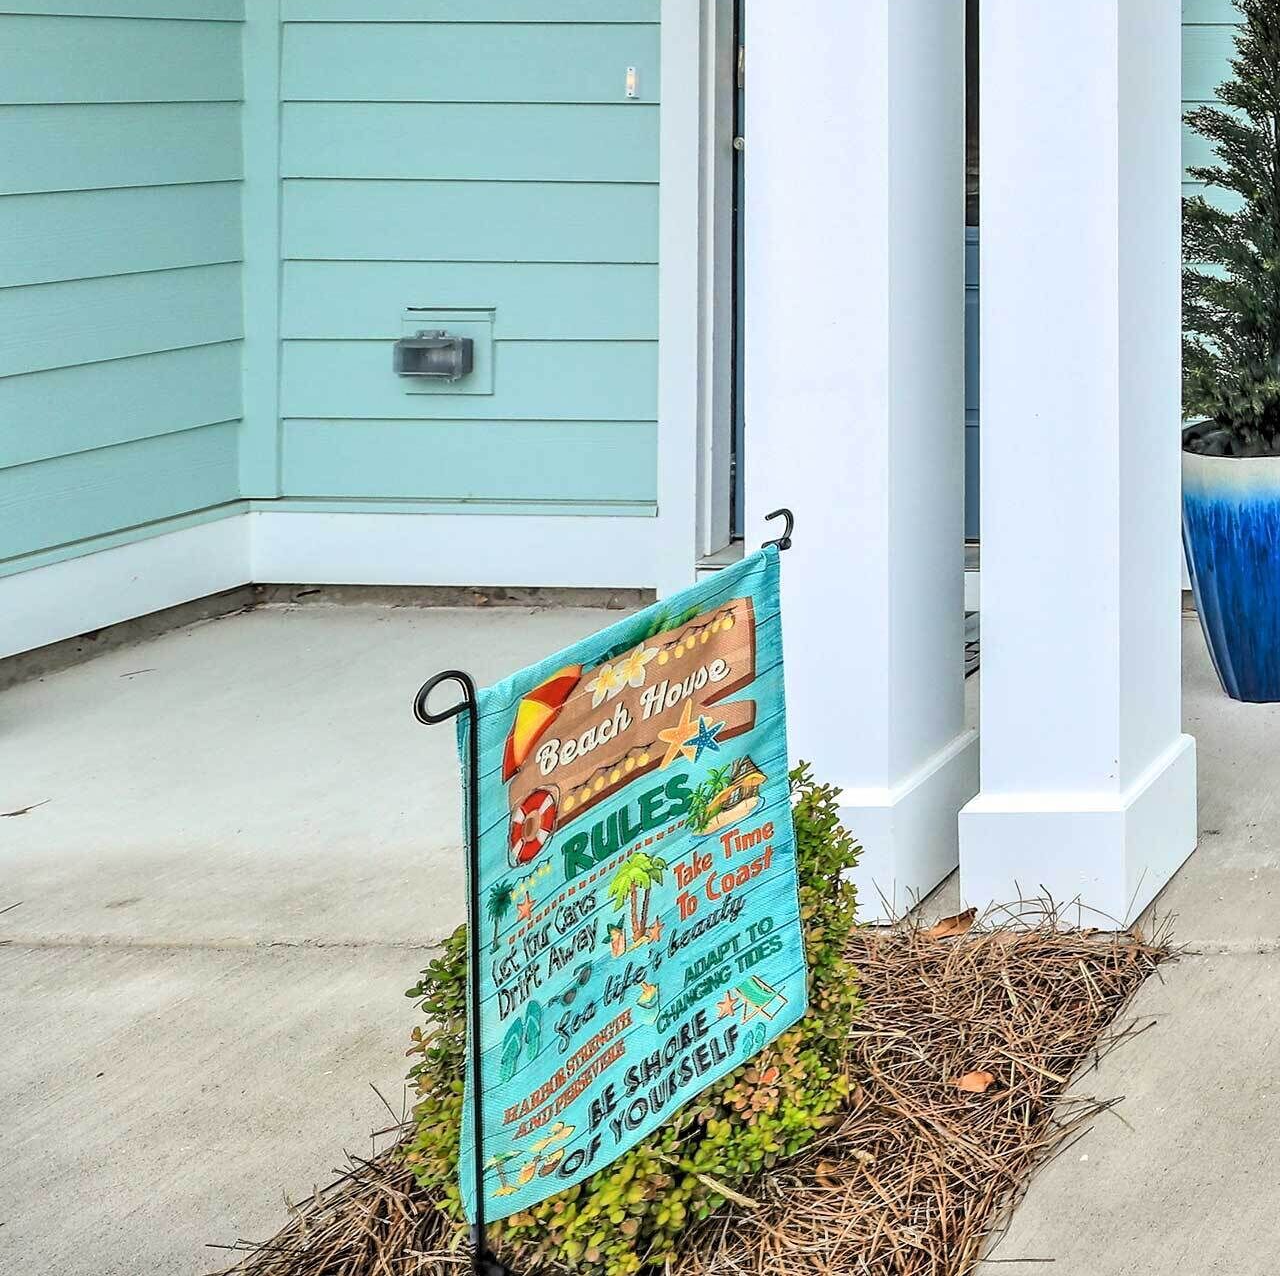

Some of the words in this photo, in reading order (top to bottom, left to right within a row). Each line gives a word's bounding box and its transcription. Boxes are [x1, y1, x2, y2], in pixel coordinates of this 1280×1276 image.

[535, 702, 633, 775] Beach
[639, 658, 732, 720] House
[560, 773, 694, 882] RULES
[673, 851, 713, 891] Take
[720, 821, 774, 859] Time
[667, 893, 747, 959] beauty
[676, 891, 698, 922] To
[705, 845, 775, 901] Coast
[656, 964, 732, 1035] CHANGING
[735, 934, 784, 974] TIDES
[684, 933, 741, 988] ADAPT
[745, 916, 774, 943] TO
[502, 1068, 567, 1126] HARBOR
[566, 1007, 633, 1077] STRENGTH
[556, 1133, 602, 1179] OF
[609, 1023, 741, 1146] YOURSELF
[587, 1082, 617, 1135] BE
[624, 1008, 710, 1098] SHORE
[512, 1104, 552, 1141] AND
